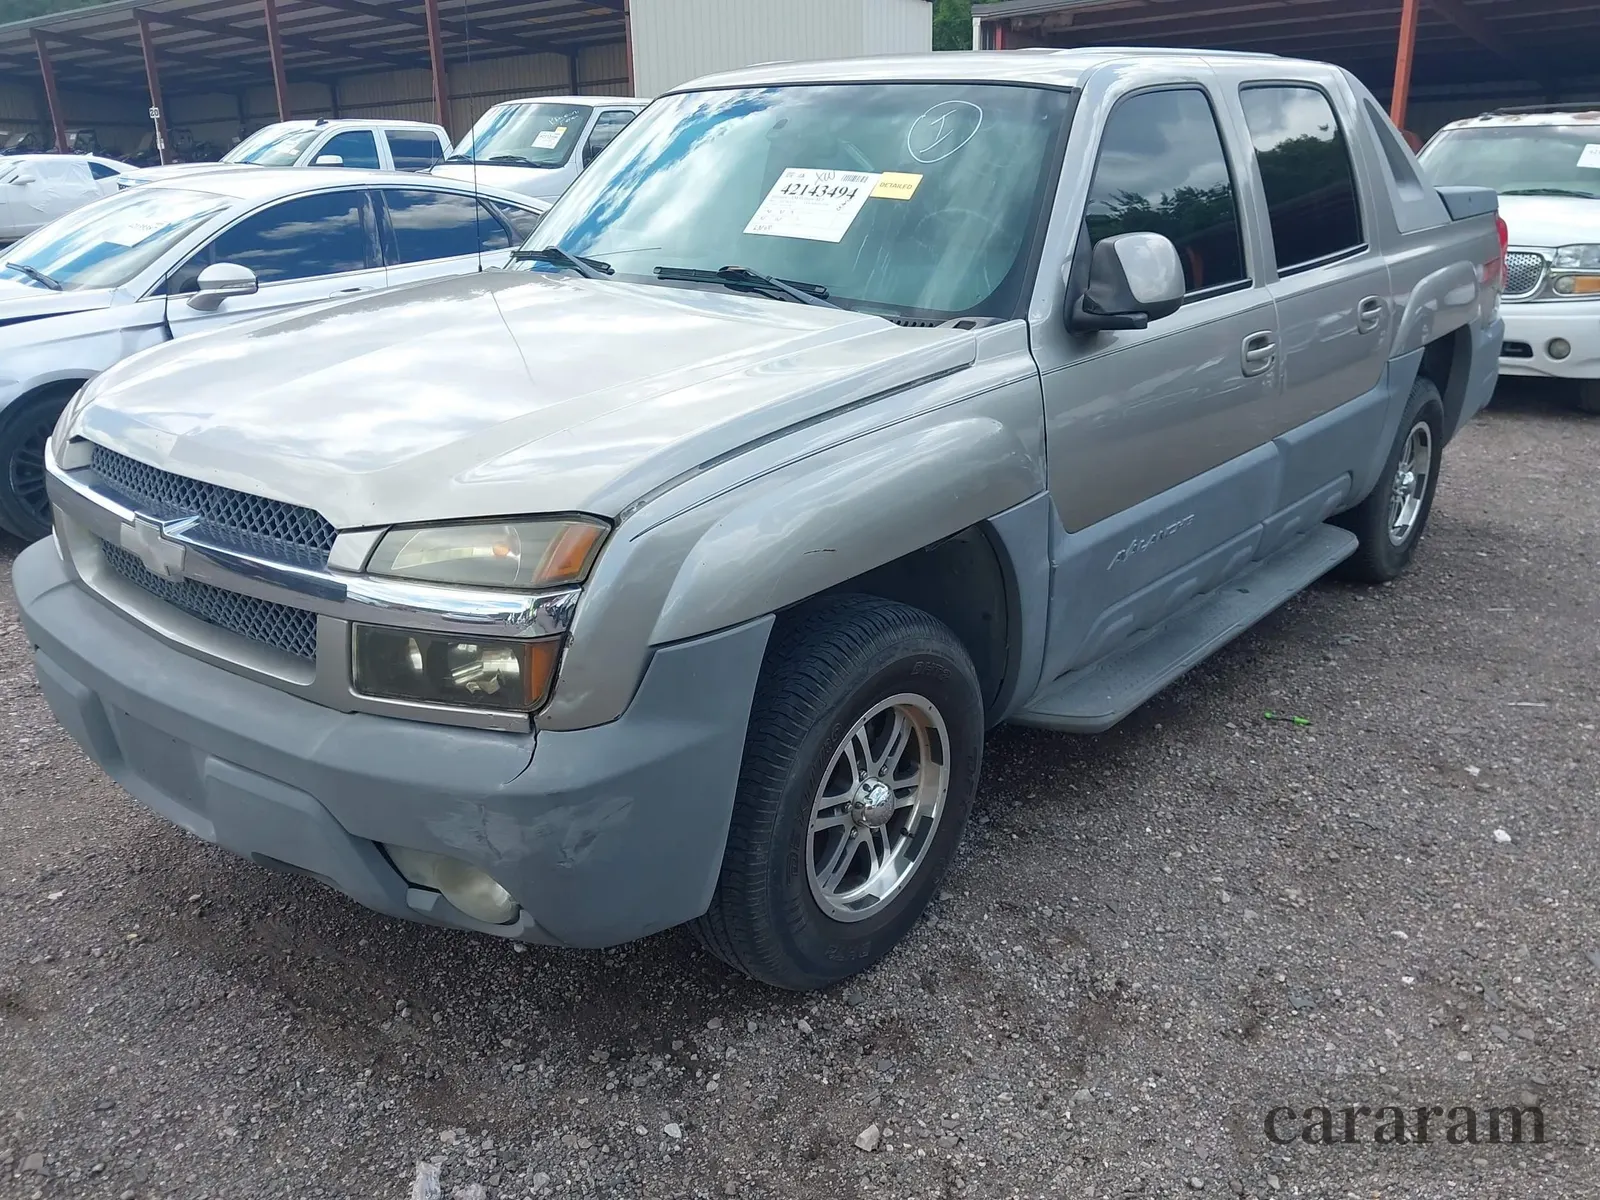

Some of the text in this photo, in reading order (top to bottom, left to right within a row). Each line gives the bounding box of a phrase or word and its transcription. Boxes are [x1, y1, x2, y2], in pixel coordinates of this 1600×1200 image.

[150, 109, 159, 117] 20
[879, 181, 913, 190] DETAILED
[780, 182, 859, 200] 42143494
